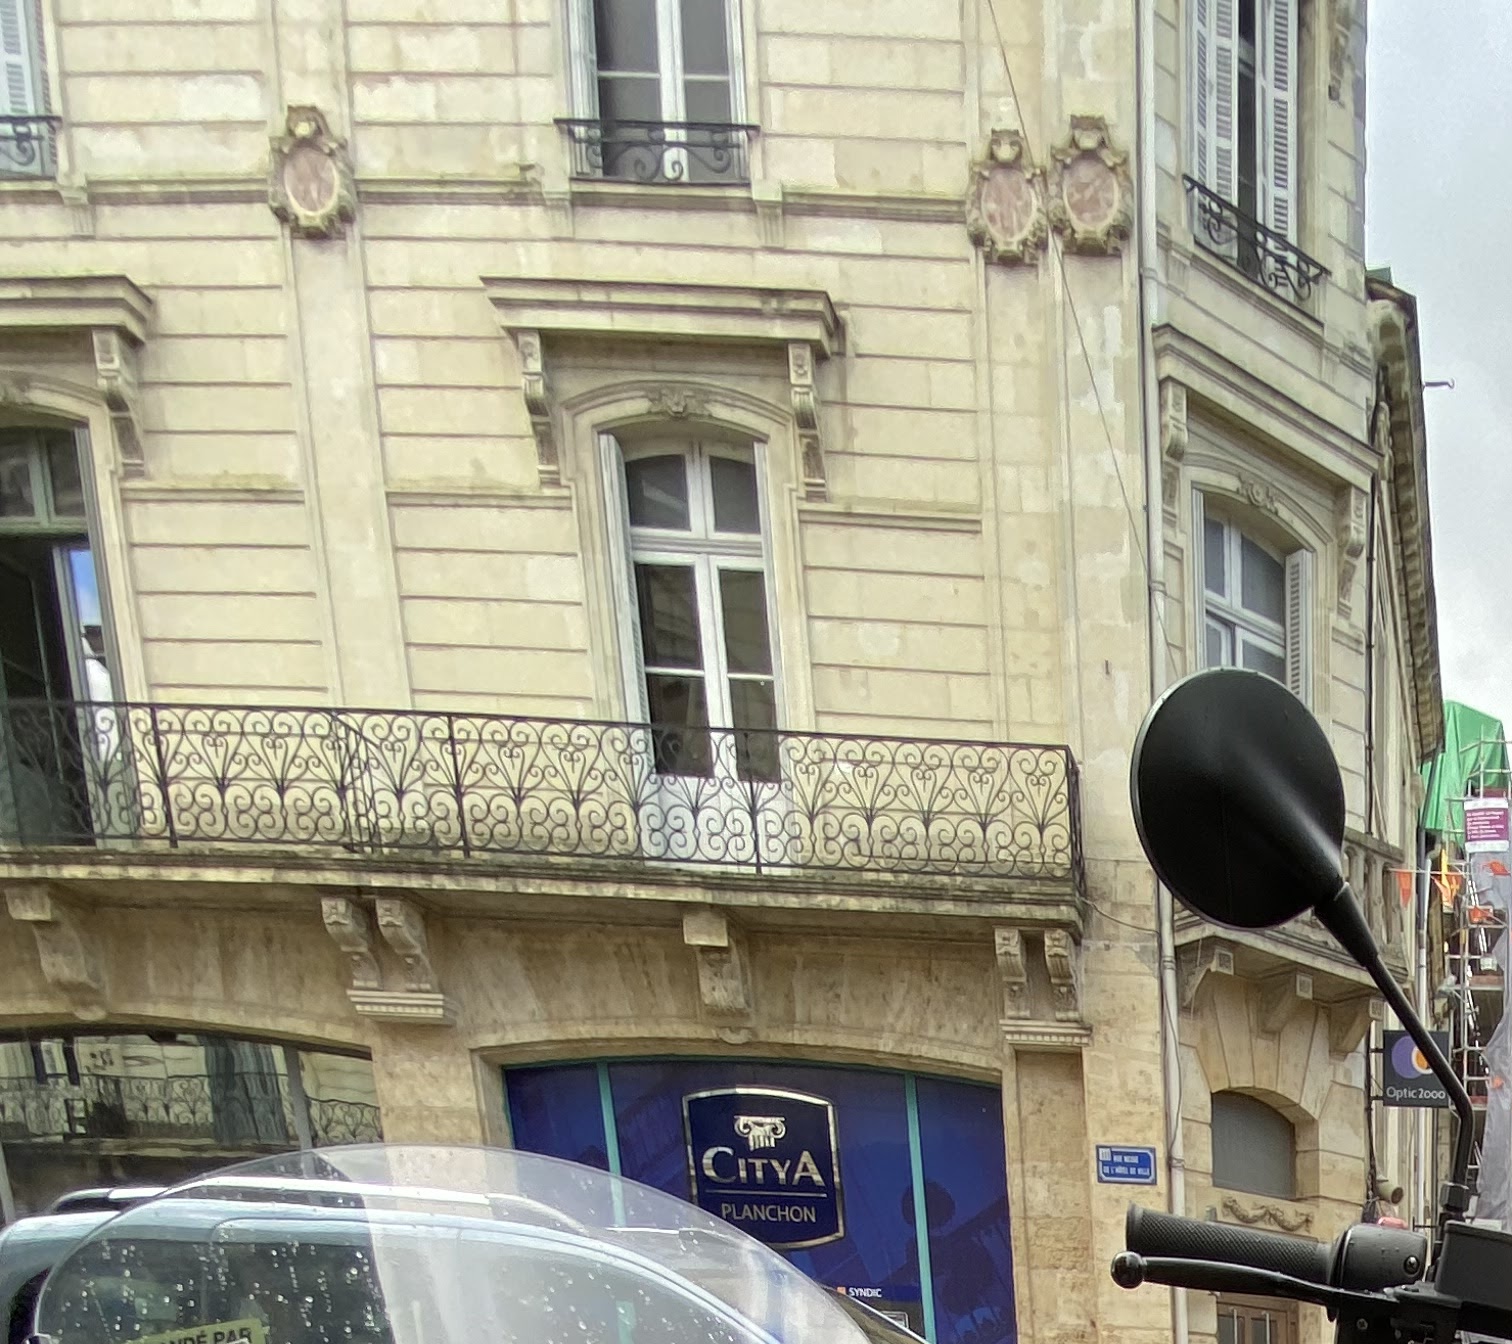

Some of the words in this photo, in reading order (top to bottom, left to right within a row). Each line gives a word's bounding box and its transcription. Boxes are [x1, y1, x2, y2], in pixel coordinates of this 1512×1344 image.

[1386, 1086, 1418, 1101] Optic
[1418, 1087, 1446, 1100] 2000
[721, 1202, 816, 1223] PLANCHON
[849, 1286, 883, 1299] SYNDIC
